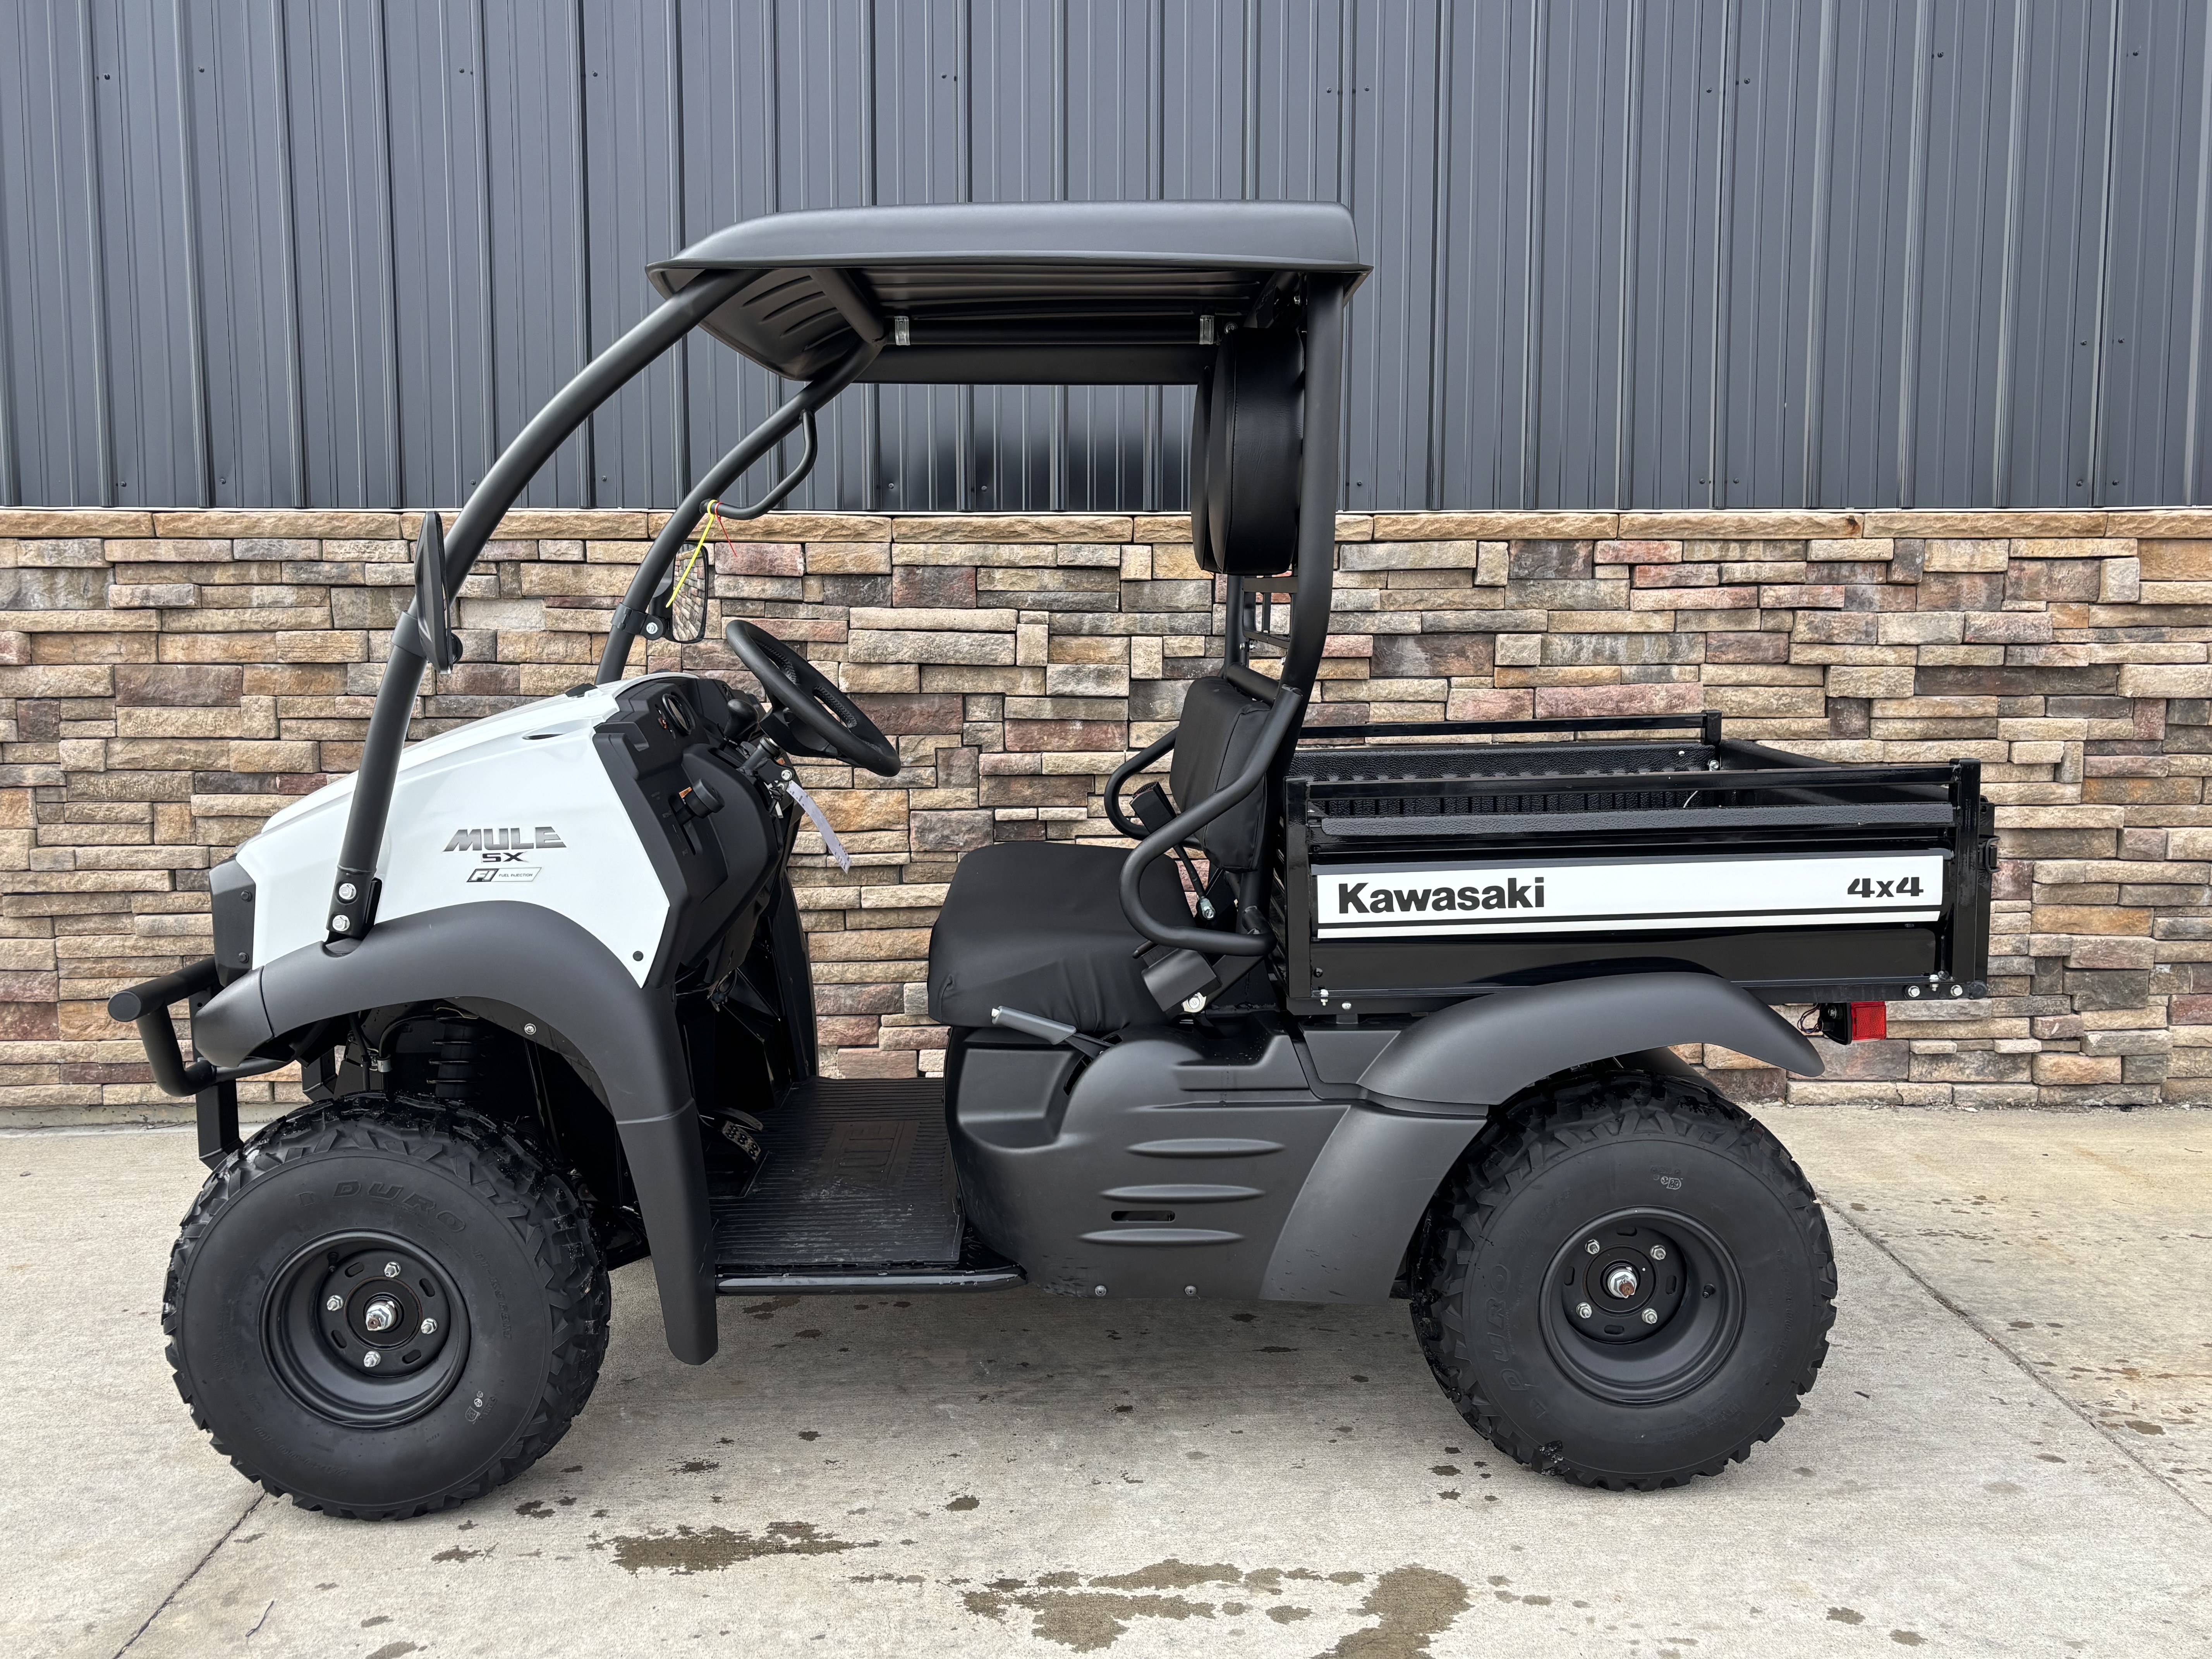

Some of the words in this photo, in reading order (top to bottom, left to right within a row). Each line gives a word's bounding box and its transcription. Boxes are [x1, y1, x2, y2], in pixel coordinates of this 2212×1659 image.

[443, 827, 567, 852] MULE
[482, 851, 529, 863] SX
[1339, 877, 1544, 914] Kawasaki
[1847, 877, 1924, 898] 4x4
[332, 1180, 465, 1233] DURO
[1486, 1263, 1528, 1391] DURO
